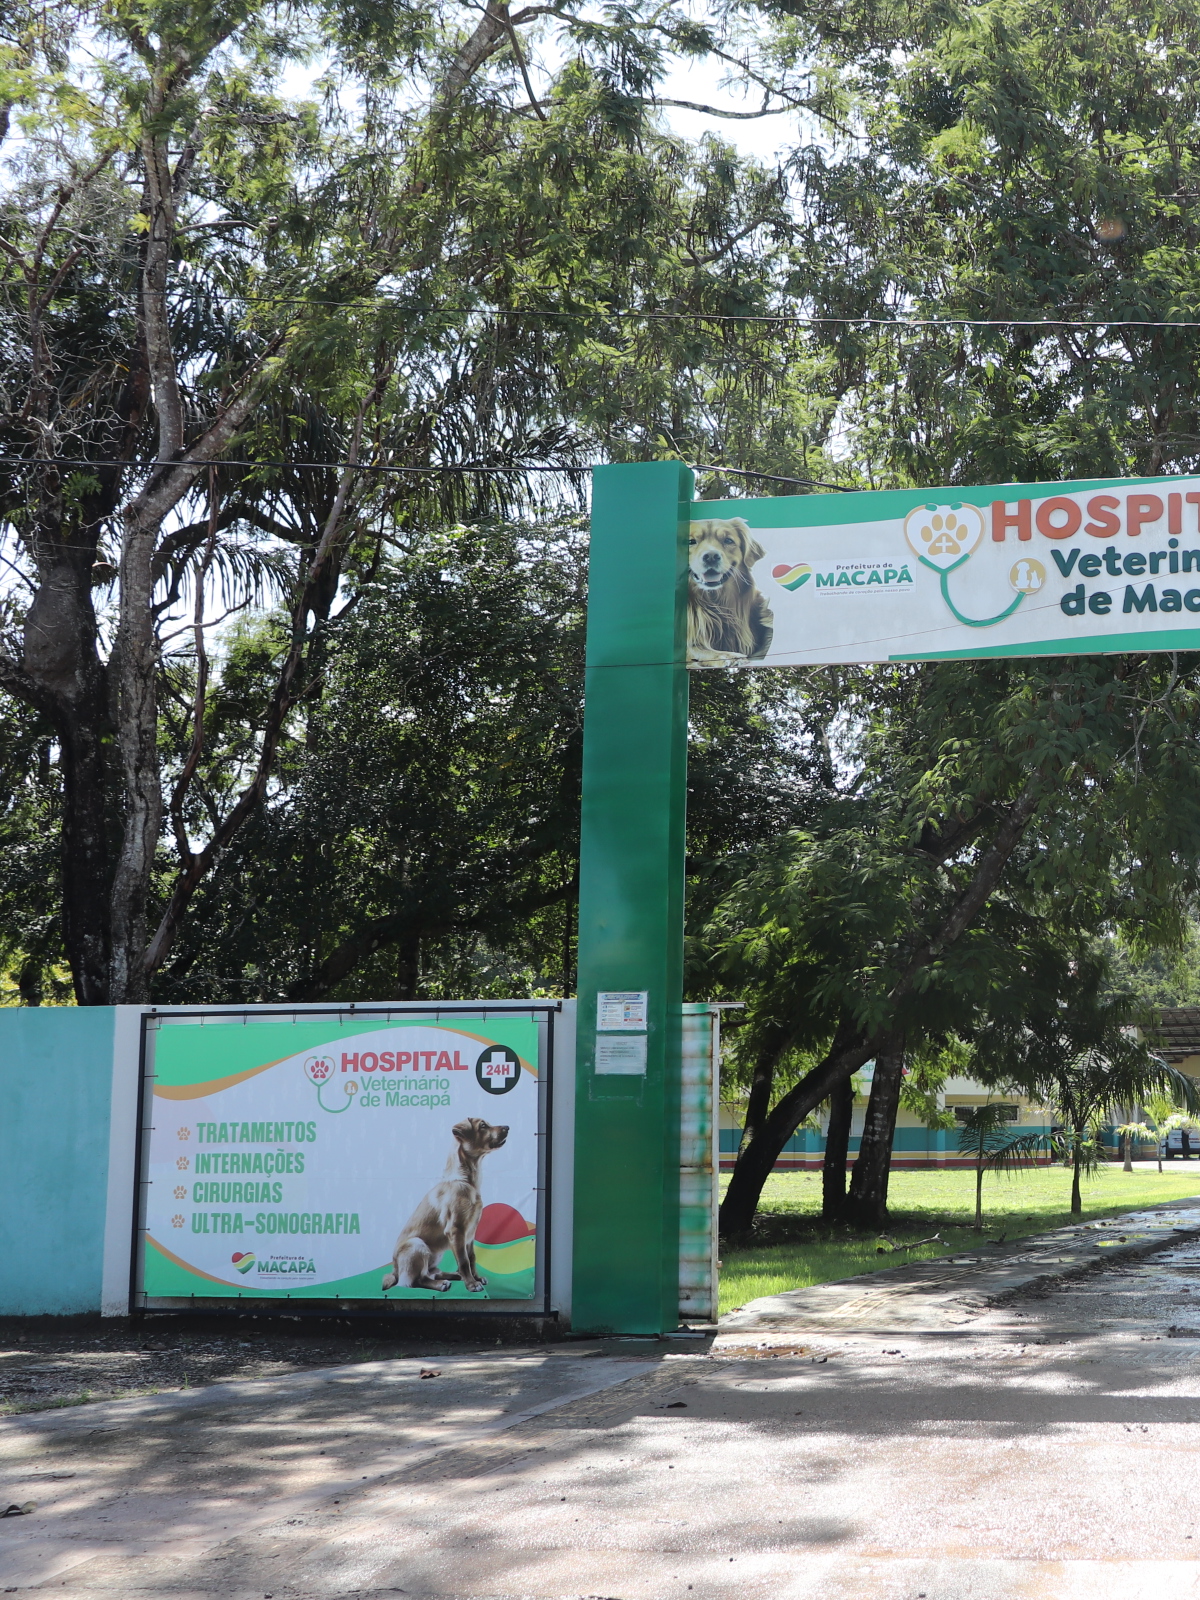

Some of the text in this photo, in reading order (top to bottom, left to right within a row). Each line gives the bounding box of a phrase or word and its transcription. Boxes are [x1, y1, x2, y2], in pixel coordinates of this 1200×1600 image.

[815, 564, 914, 588] MACAPÁ
[836, 563, 881, 571] Prefeitura
[1060, 584, 1112, 617] de
[341, 1051, 469, 1073] HOSPITAL
[486, 1064, 510, 1076] 24H
[360, 1075, 450, 1091] Veterinário
[359, 1091, 451, 1110] de Macapá
[196, 1121, 317, 1143] TRATAMENTOS
[195, 1148, 305, 1178] INTERNAÇÕES
[192, 1181, 283, 1203] CIRURGIAS
[191, 1212, 361, 1234] ULTRA-SONOGRAFIA
[257, 1258, 316, 1273] MACAPÁ
